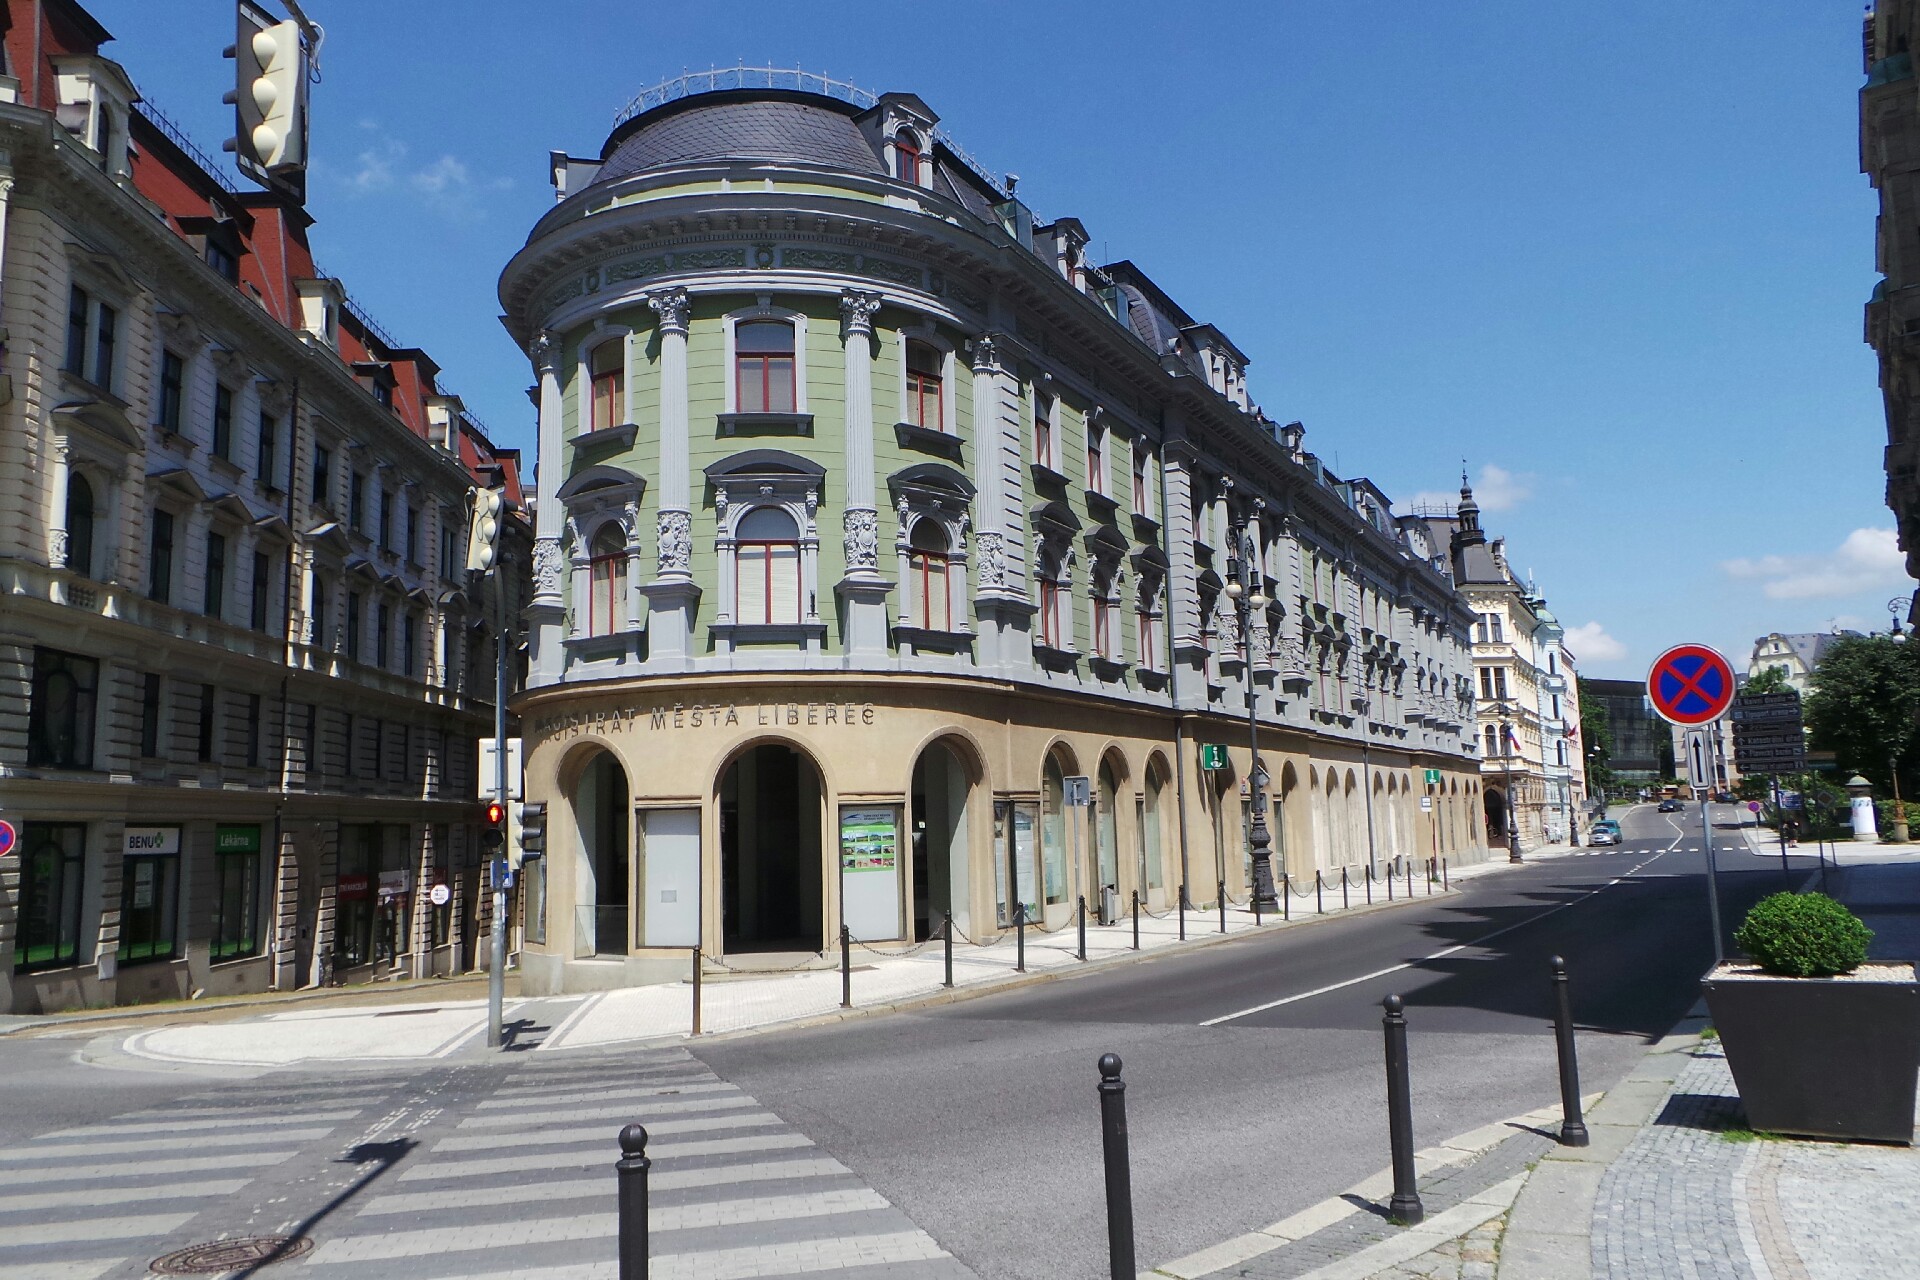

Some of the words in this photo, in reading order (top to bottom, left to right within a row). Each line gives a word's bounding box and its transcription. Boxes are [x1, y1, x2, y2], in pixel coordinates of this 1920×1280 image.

[650, 702, 739, 729] MĚSTA
[758, 702, 874, 726] LIBEREC
[129, 836, 154, 849] BENU
[220, 833, 249, 847] Lékárna
